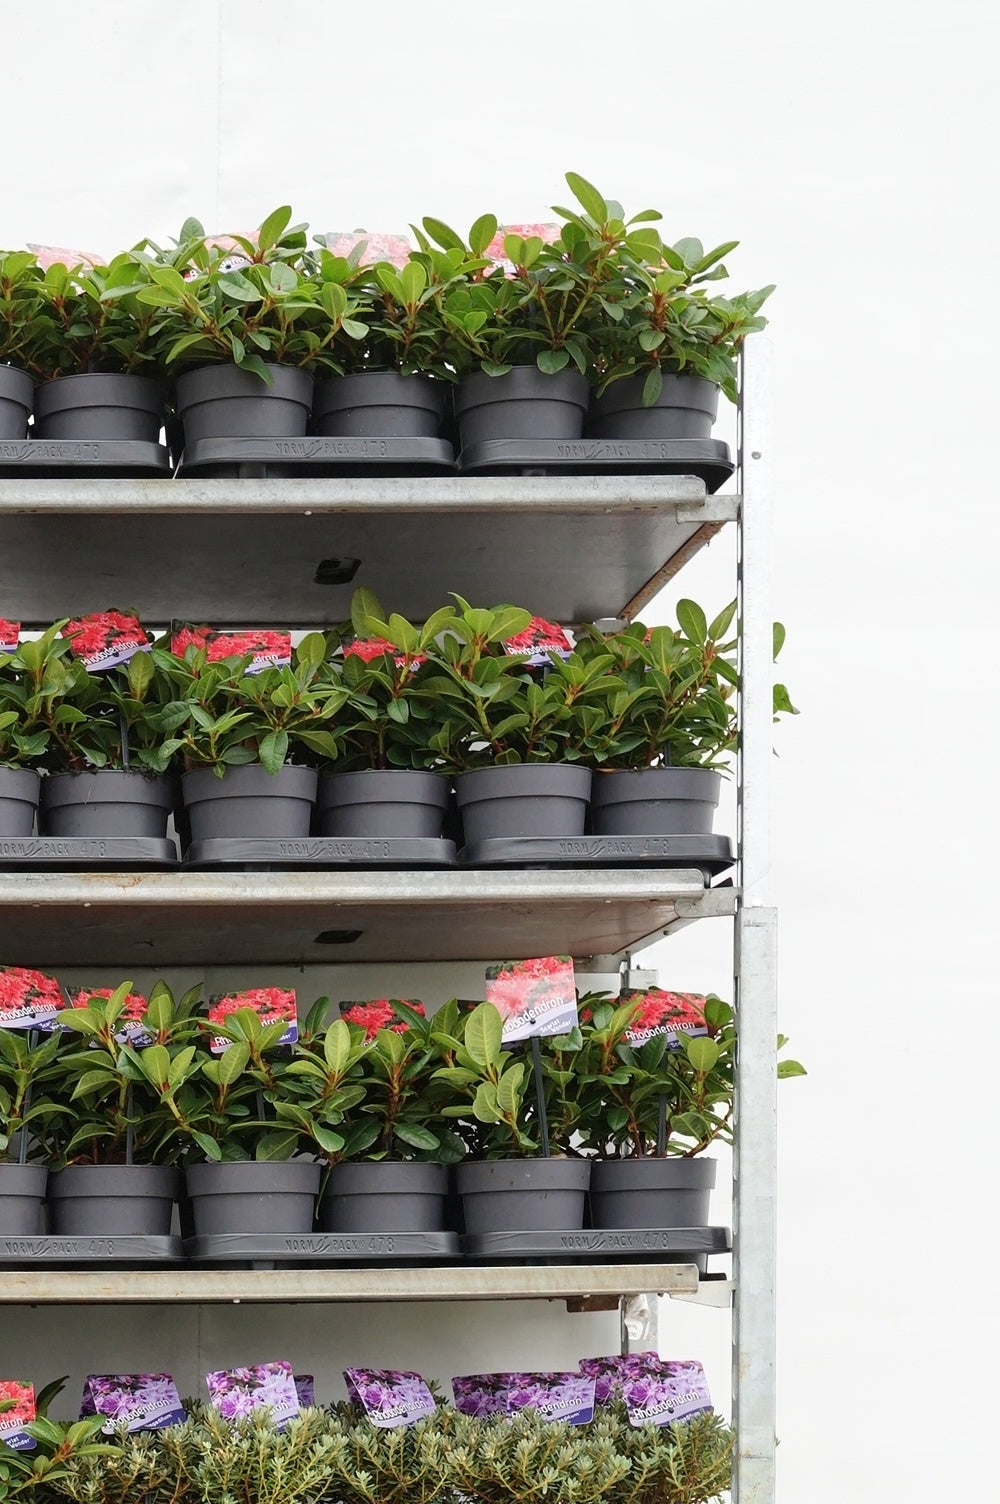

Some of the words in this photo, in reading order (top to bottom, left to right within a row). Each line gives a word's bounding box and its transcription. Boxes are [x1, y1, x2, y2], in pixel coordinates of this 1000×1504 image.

[502, 996, 564, 1033] hododendron
[625, 1021, 695, 1041] Rhododendron
[106, 1398, 170, 1428] Rhododendron
[634, 1391, 699, 1419] Rhododendron
